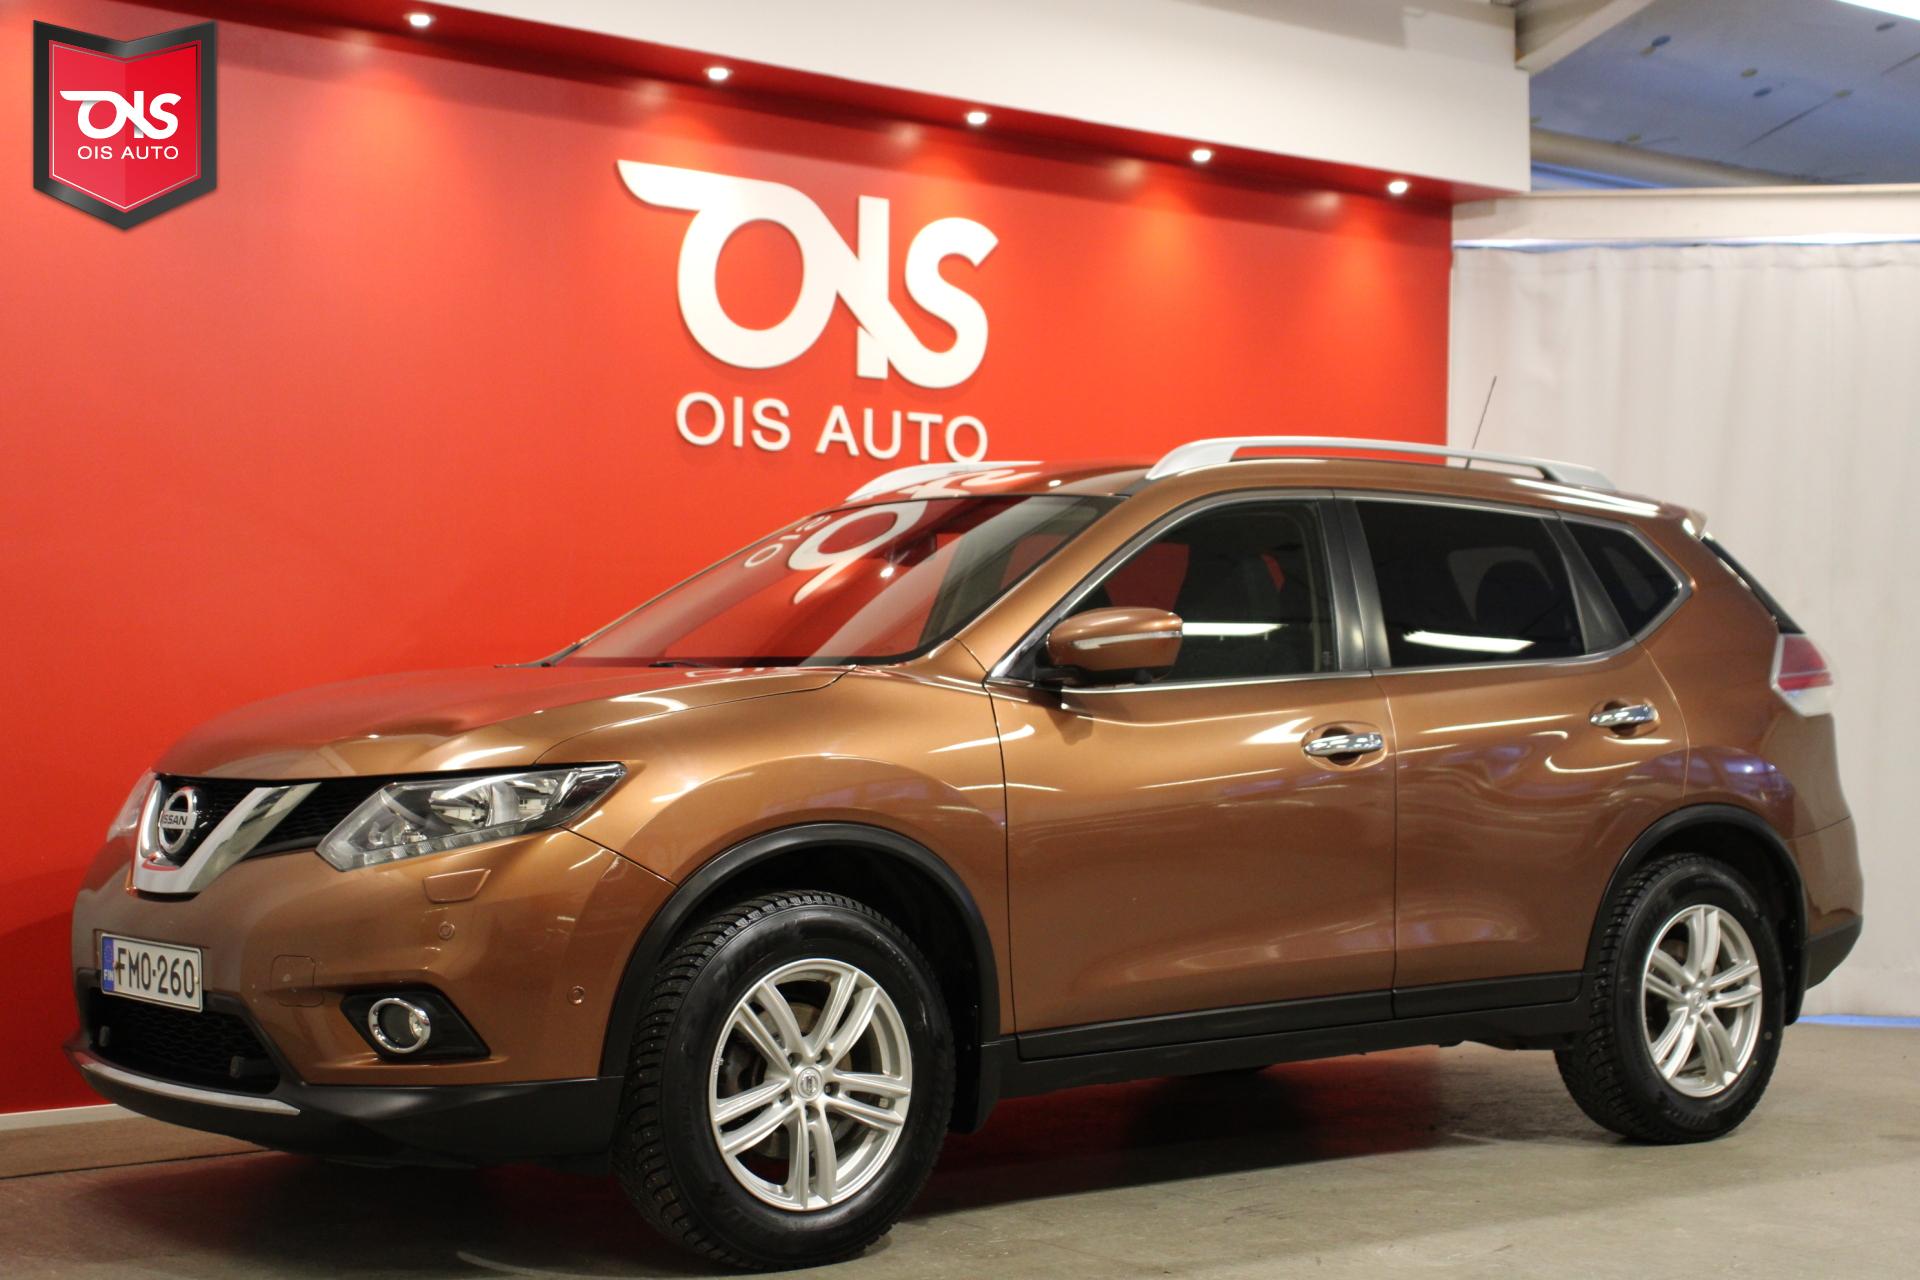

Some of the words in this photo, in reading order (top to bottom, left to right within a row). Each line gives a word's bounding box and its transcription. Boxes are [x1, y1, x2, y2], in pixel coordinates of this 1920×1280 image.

[616, 159, 999, 389] OIS
[675, 391, 791, 452] OIS
[815, 405, 988, 463] AUTO
[103, 968, 114, 982] FIN
[117, 947, 195, 999] FMO-260
